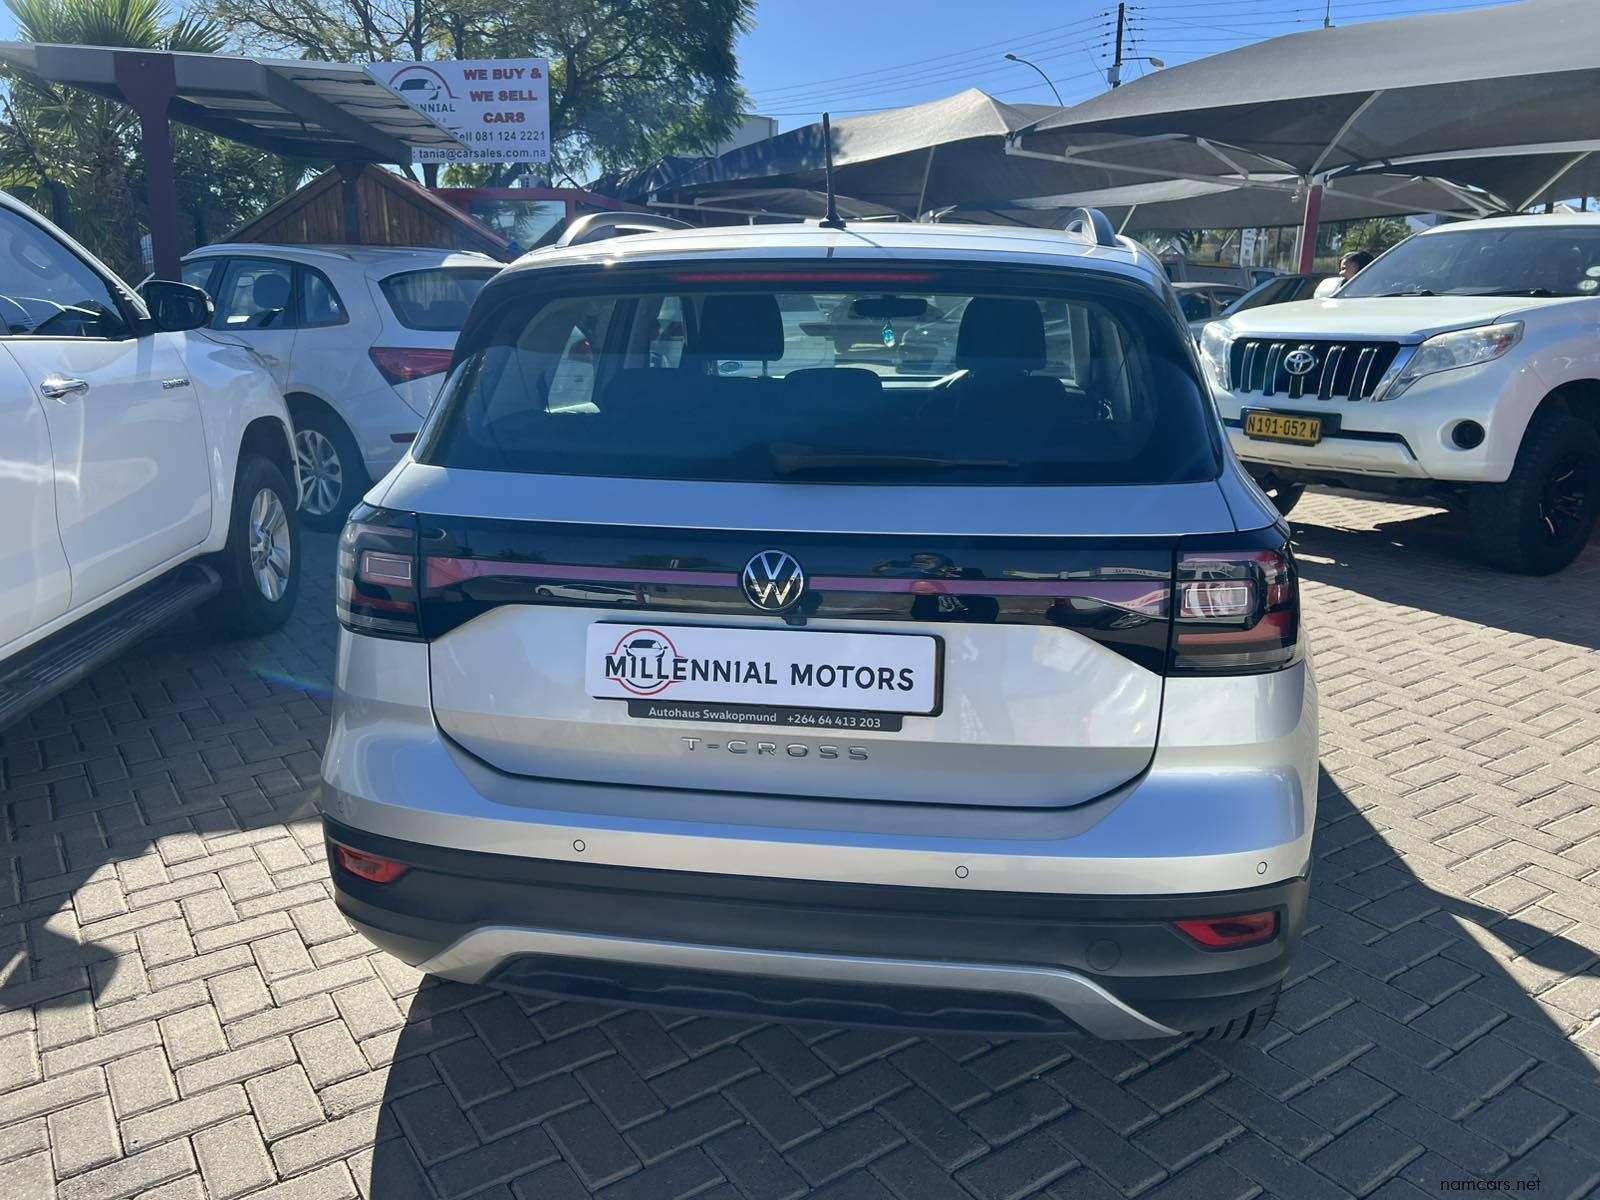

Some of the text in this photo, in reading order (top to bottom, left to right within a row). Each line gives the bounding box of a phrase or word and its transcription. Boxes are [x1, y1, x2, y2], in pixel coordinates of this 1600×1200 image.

[463, 68, 542, 80] WE BUY &
[469, 91, 537, 102] WE SELL
[415, 103, 456, 113] NNIAL
[483, 112, 526, 124] CARS
[475, 131, 494, 141] 081
[498, 131, 517, 141] 124
[520, 130, 545, 141] 2221
[419, 149, 546, 160] tania@carsales.com.na
[604, 655, 915, 692] MILLENNIAL MOTORS
[648, 706, 881, 728] Autohaus Swakopmund +264 64 413 203
[681, 736, 870, 761] T-CROSS
